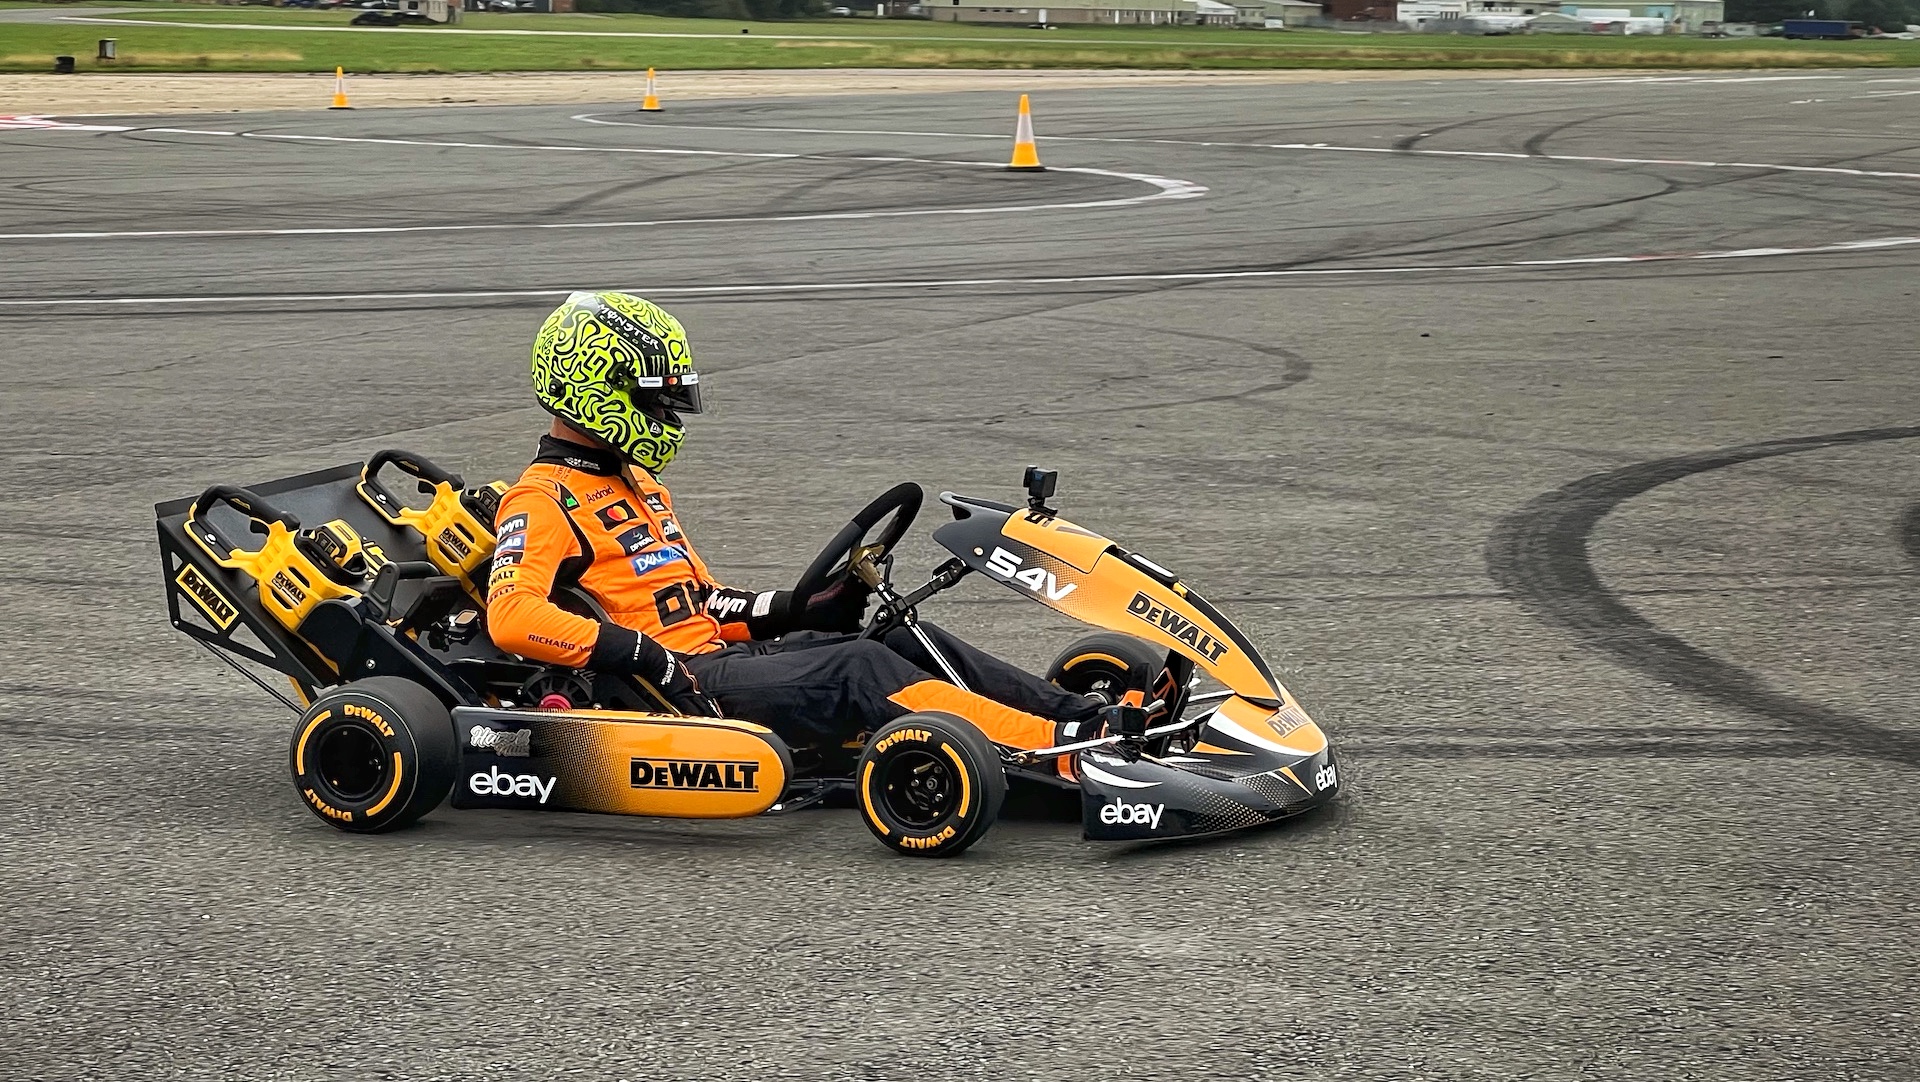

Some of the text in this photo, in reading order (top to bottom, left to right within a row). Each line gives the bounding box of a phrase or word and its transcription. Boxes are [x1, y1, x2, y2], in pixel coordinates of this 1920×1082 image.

[585, 484, 615, 504] Android
[442, 527, 471, 557] DEWALT
[635, 553, 664, 572] DELL
[984, 546, 1078, 601] 54V
[276, 570, 306, 602] DEWALT
[489, 570, 515, 588] WALT
[182, 568, 235, 623] DEWALT
[528, 633, 576, 652] RICHARD
[1126, 592, 1229, 662] DEWALT
[343, 704, 395, 737] DEWALT
[875, 729, 932, 754] DEWALT
[469, 766, 557, 804] ebay
[631, 761, 758, 790] DEWALT
[304, 788, 354, 822] DEWALT
[1100, 796, 1165, 830] ebay
[900, 825, 956, 849] DEWALT
